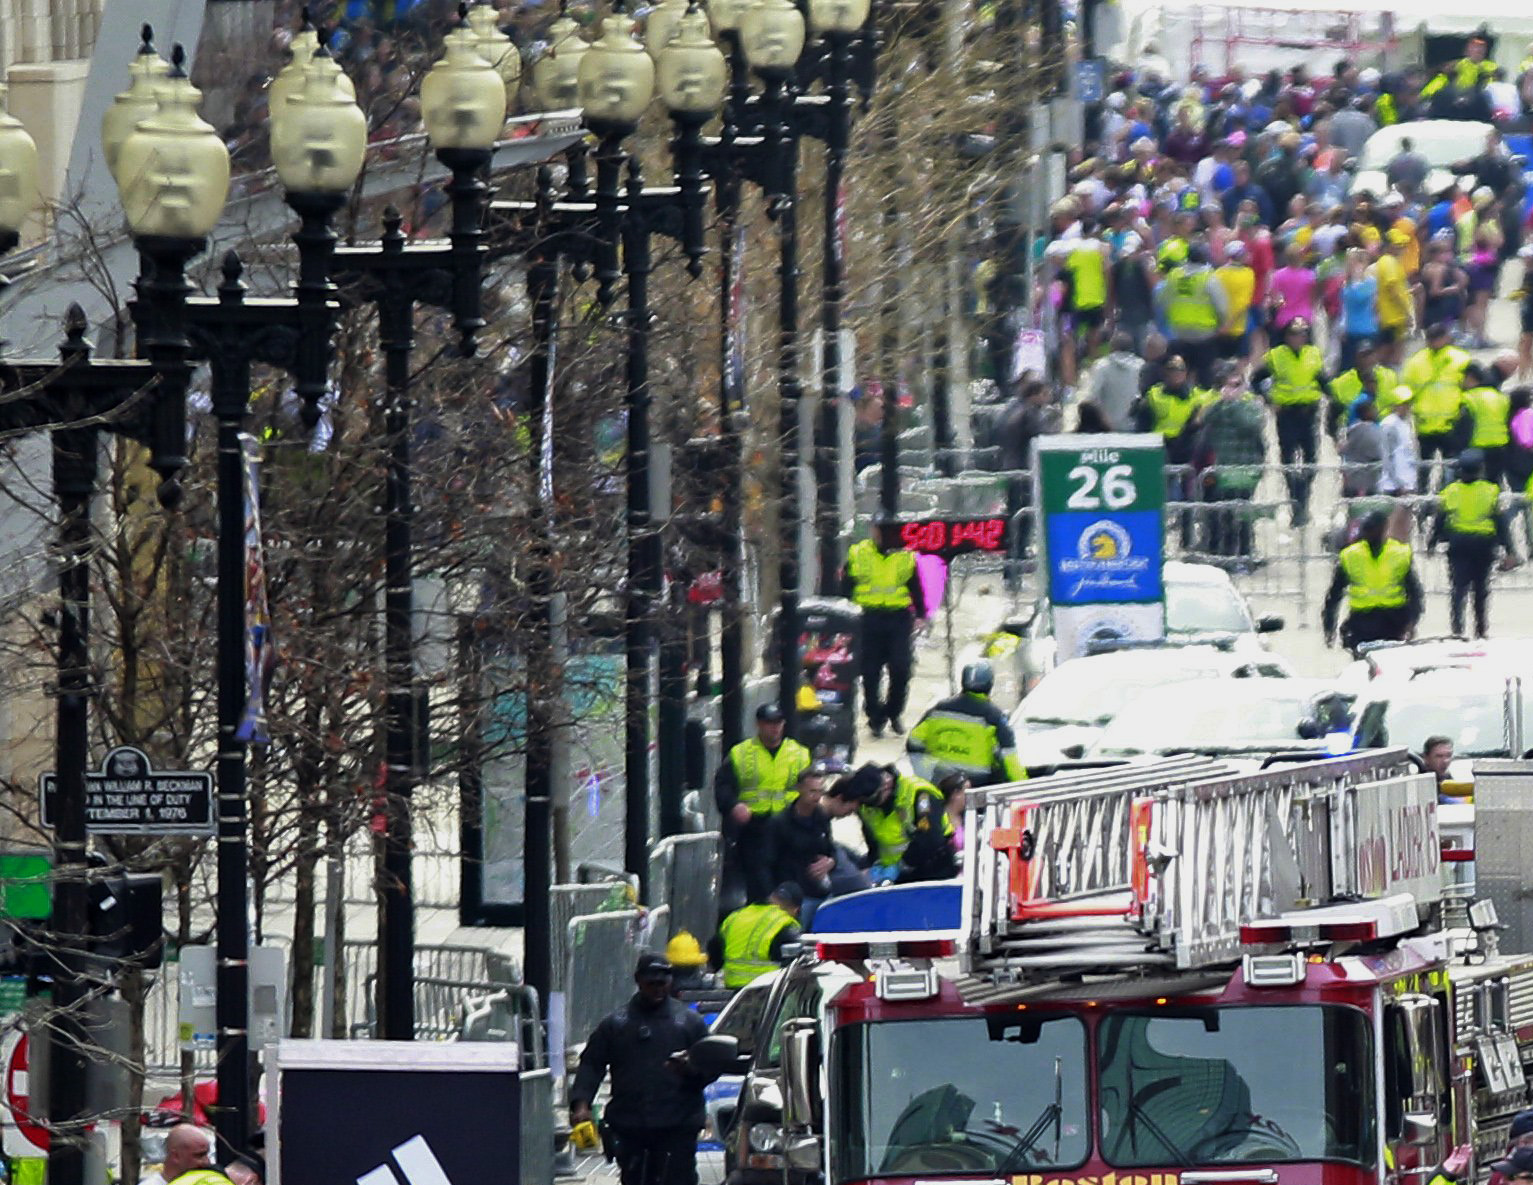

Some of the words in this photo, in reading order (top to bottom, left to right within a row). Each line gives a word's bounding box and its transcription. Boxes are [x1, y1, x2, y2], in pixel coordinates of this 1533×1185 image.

[1066, 465, 1137, 510] 26
[107, 795, 124, 805] THE
[126, 795, 148, 805] LINE
[166, 794, 192, 805] DUTY
[85, 808, 140, 819] TEMBER
